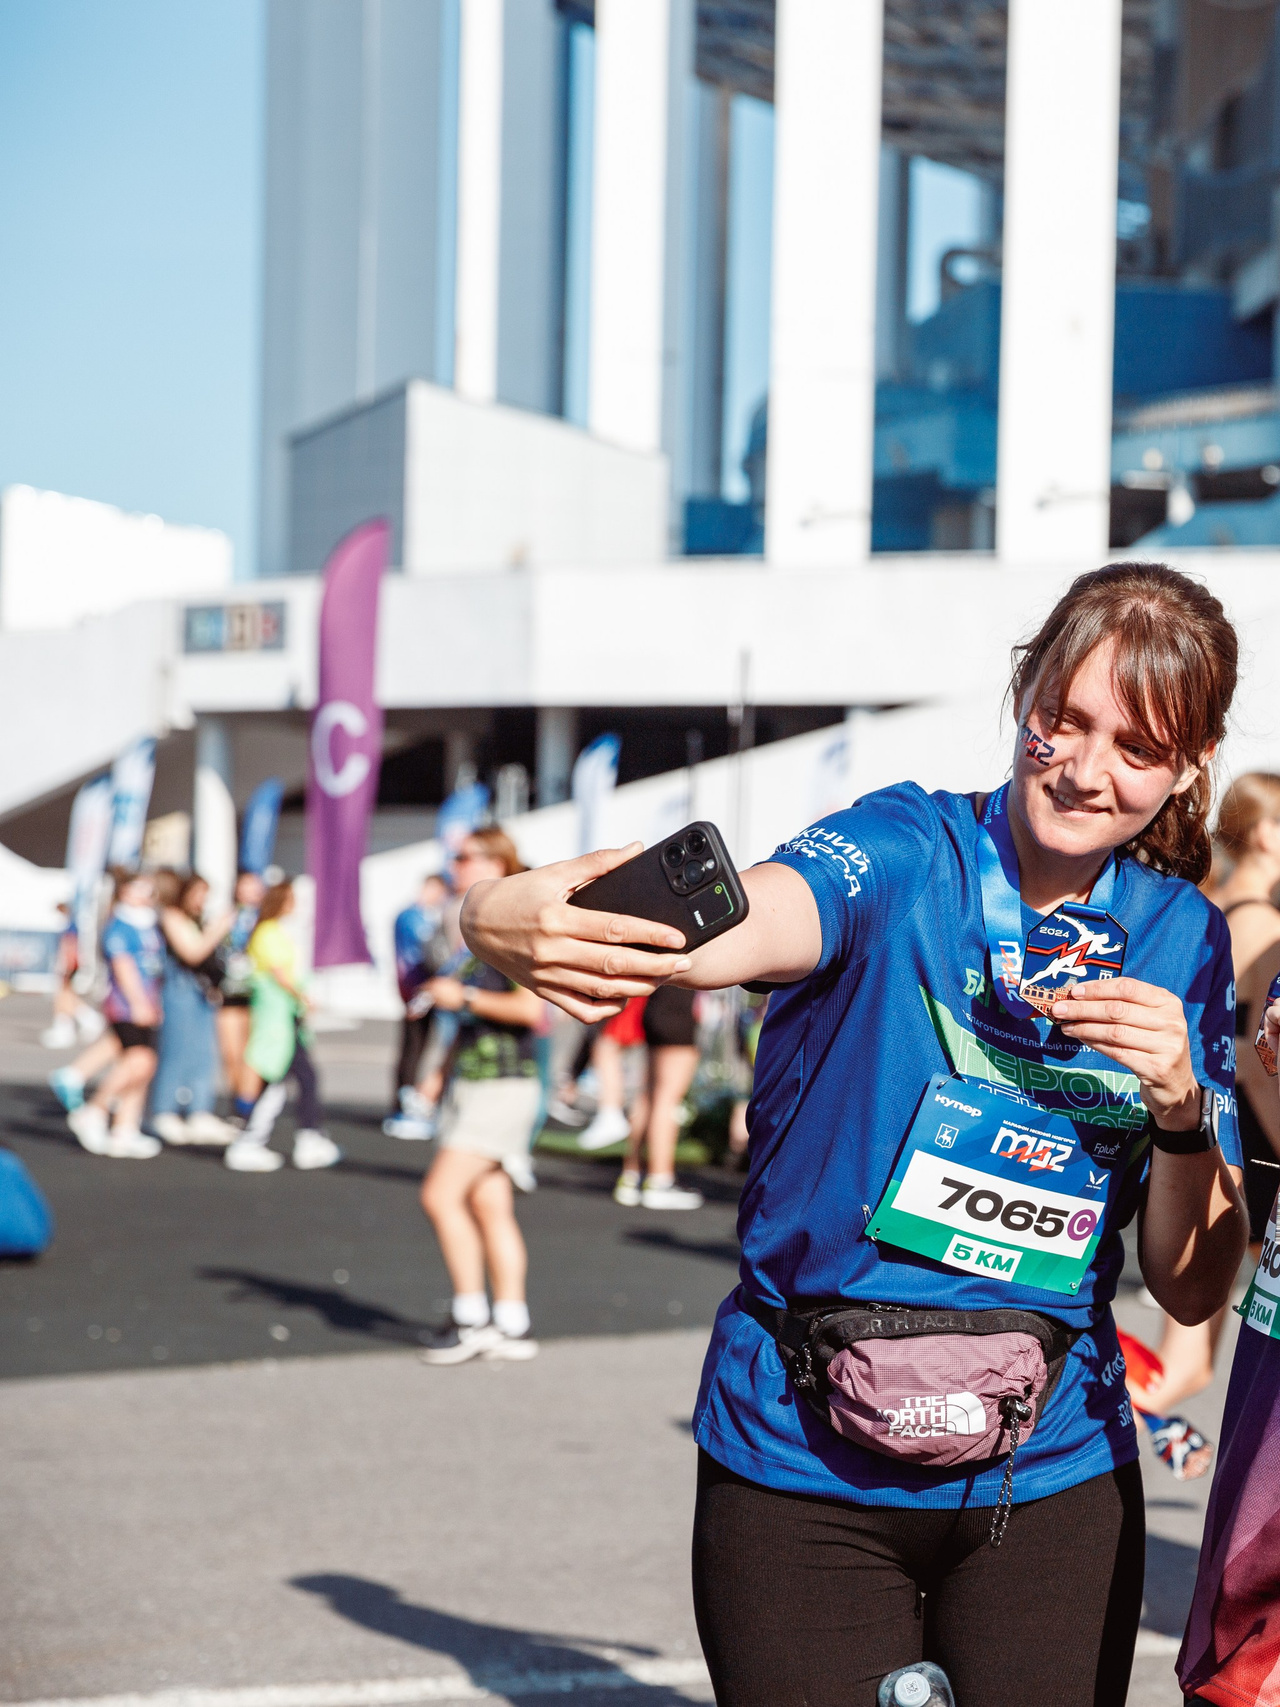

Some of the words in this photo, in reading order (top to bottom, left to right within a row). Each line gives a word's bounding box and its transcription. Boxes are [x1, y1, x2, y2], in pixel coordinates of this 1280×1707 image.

[312, 700, 368, 797] C
[1039, 926, 1070, 938] 2024
[1002, 1119, 1030, 1132] МАРАФОН
[1051, 1133, 1077, 1145] НОВГОРОД
[938, 1177, 1070, 1238] 7065
[952, 1242, 974, 1261] 5
[1250, 1301, 1257, 1318] 5
[901, 1396, 946, 1408] THE
[889, 1423, 946, 1438] FACE
